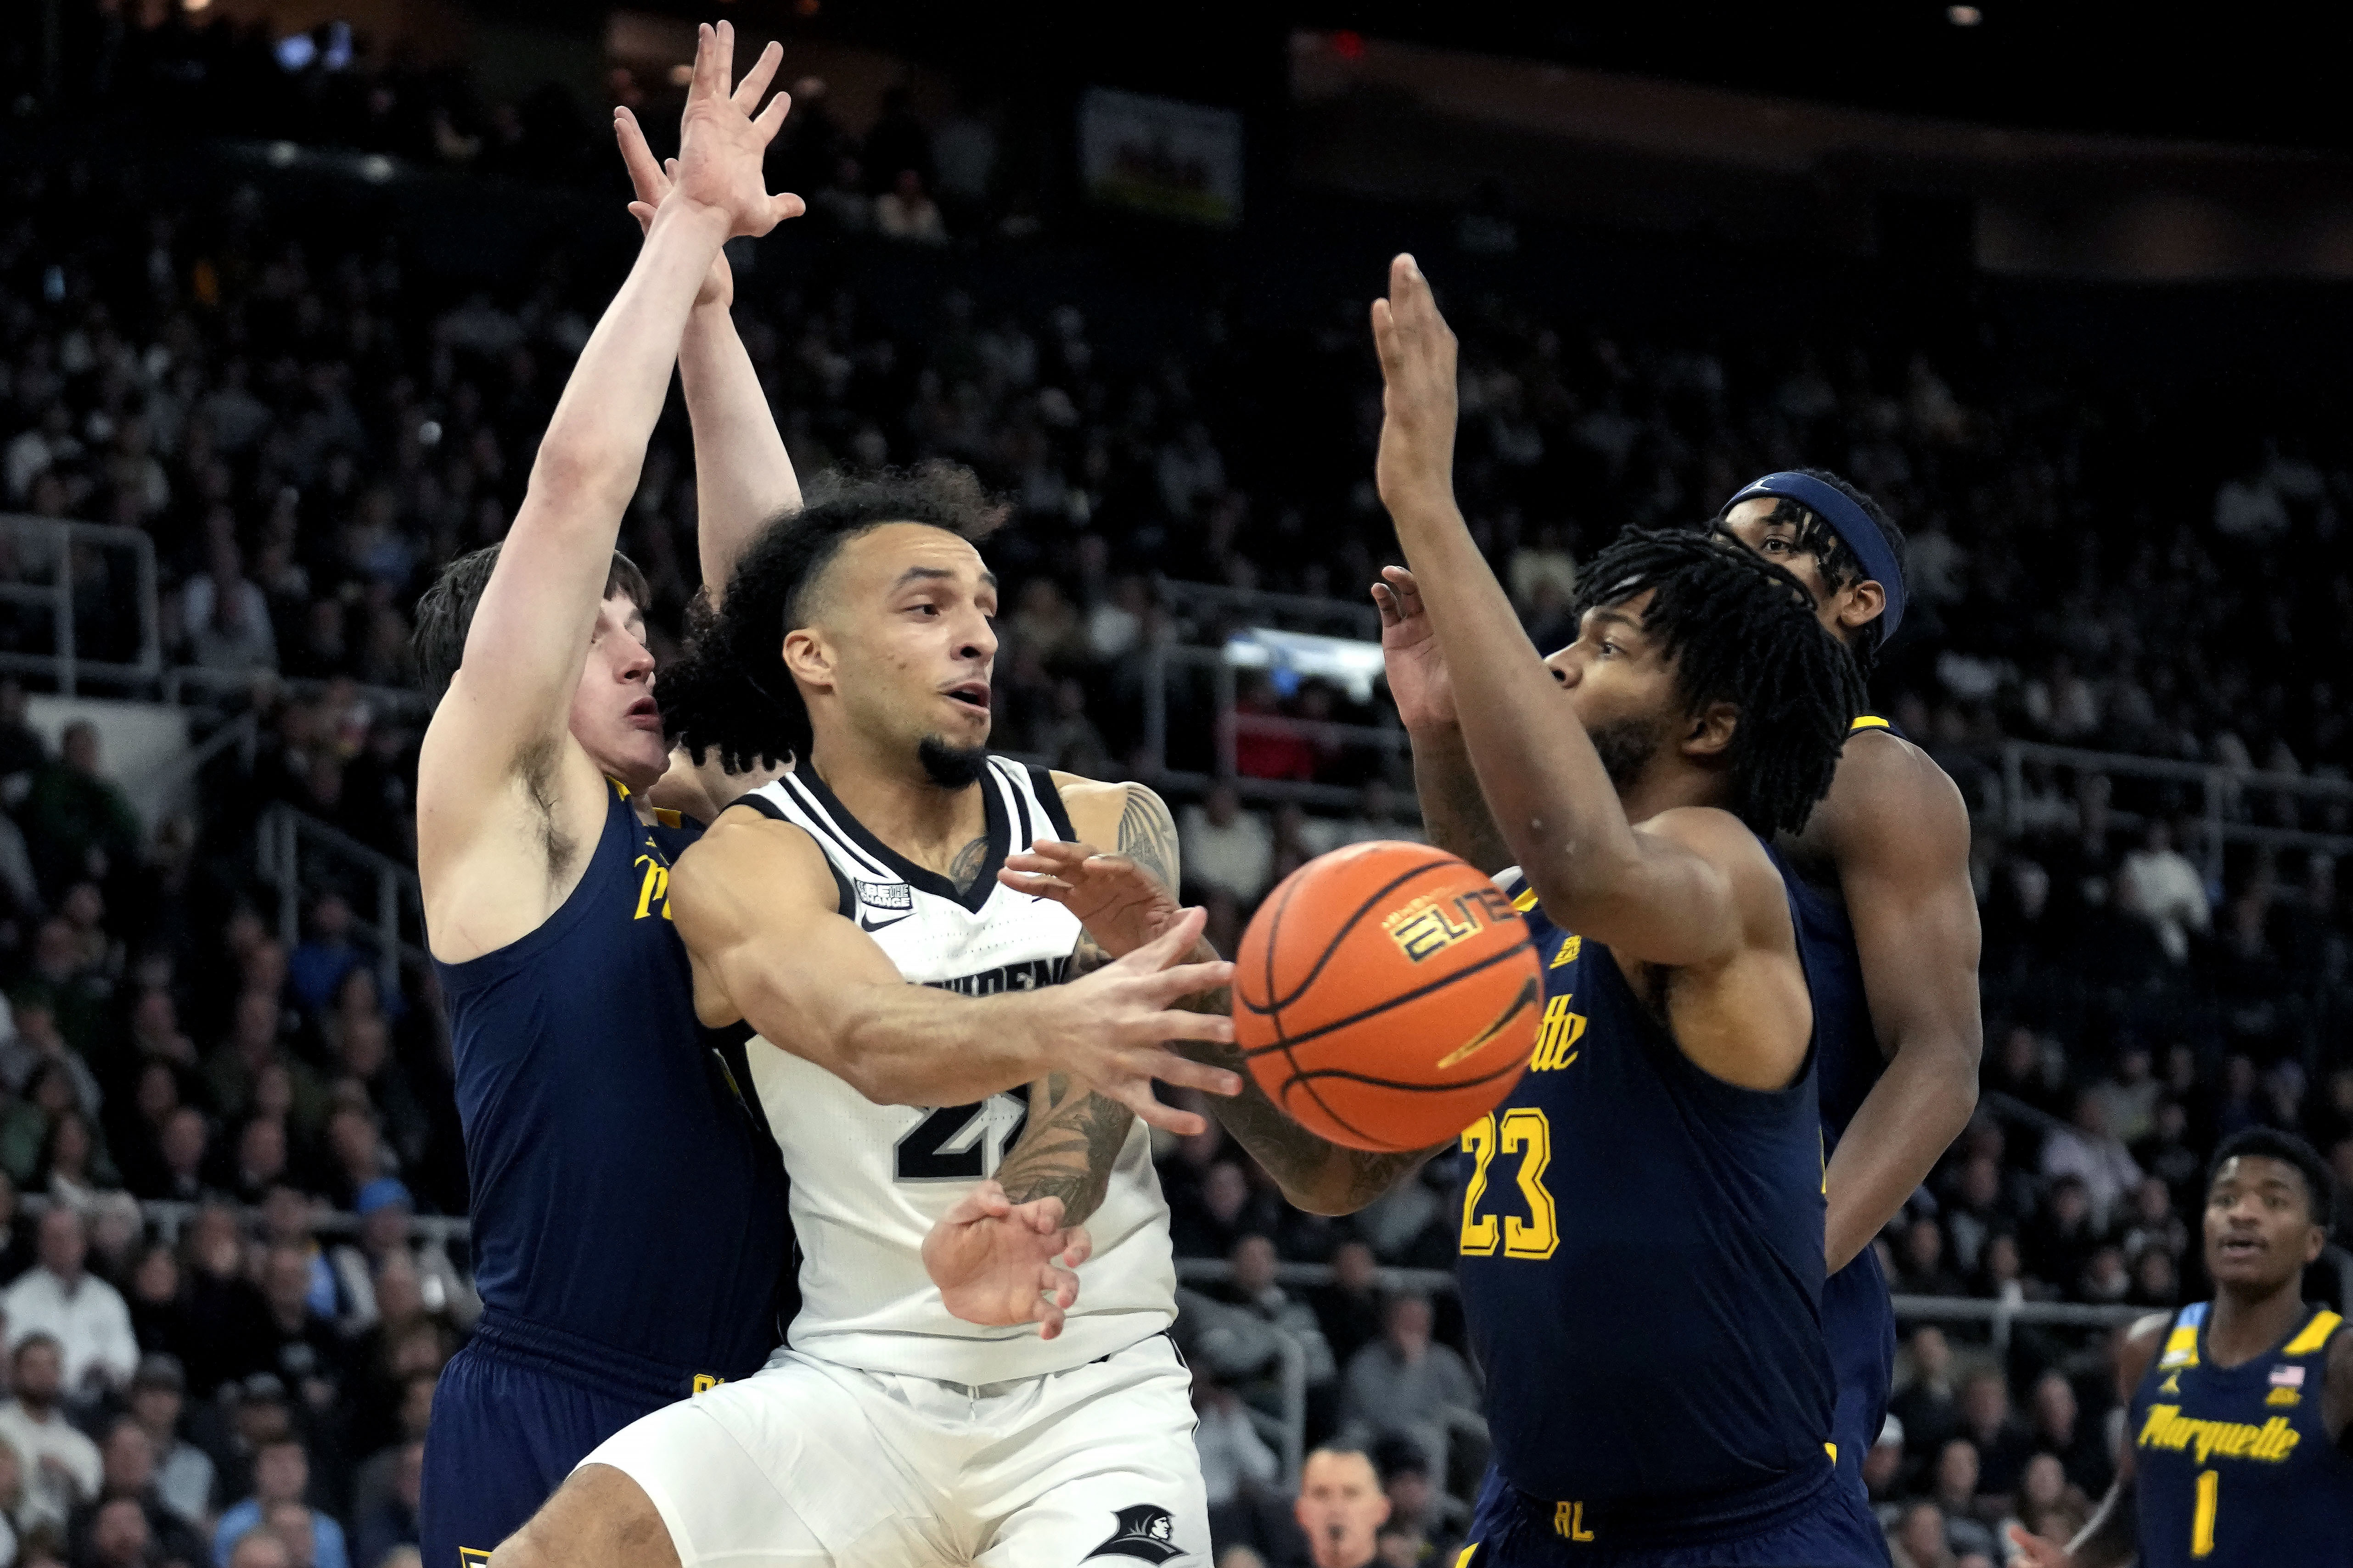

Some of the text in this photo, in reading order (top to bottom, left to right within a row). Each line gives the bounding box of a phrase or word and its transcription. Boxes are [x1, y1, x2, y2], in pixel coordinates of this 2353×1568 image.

[866, 883, 889, 896] BE
[889, 884, 909, 897] THE
[1393, 887, 1514, 963] ELITE
[1459, 1107, 1560, 1260] 23
[2138, 1403, 2301, 1465] Marquette
[2191, 1470, 2218, 1558] 1
